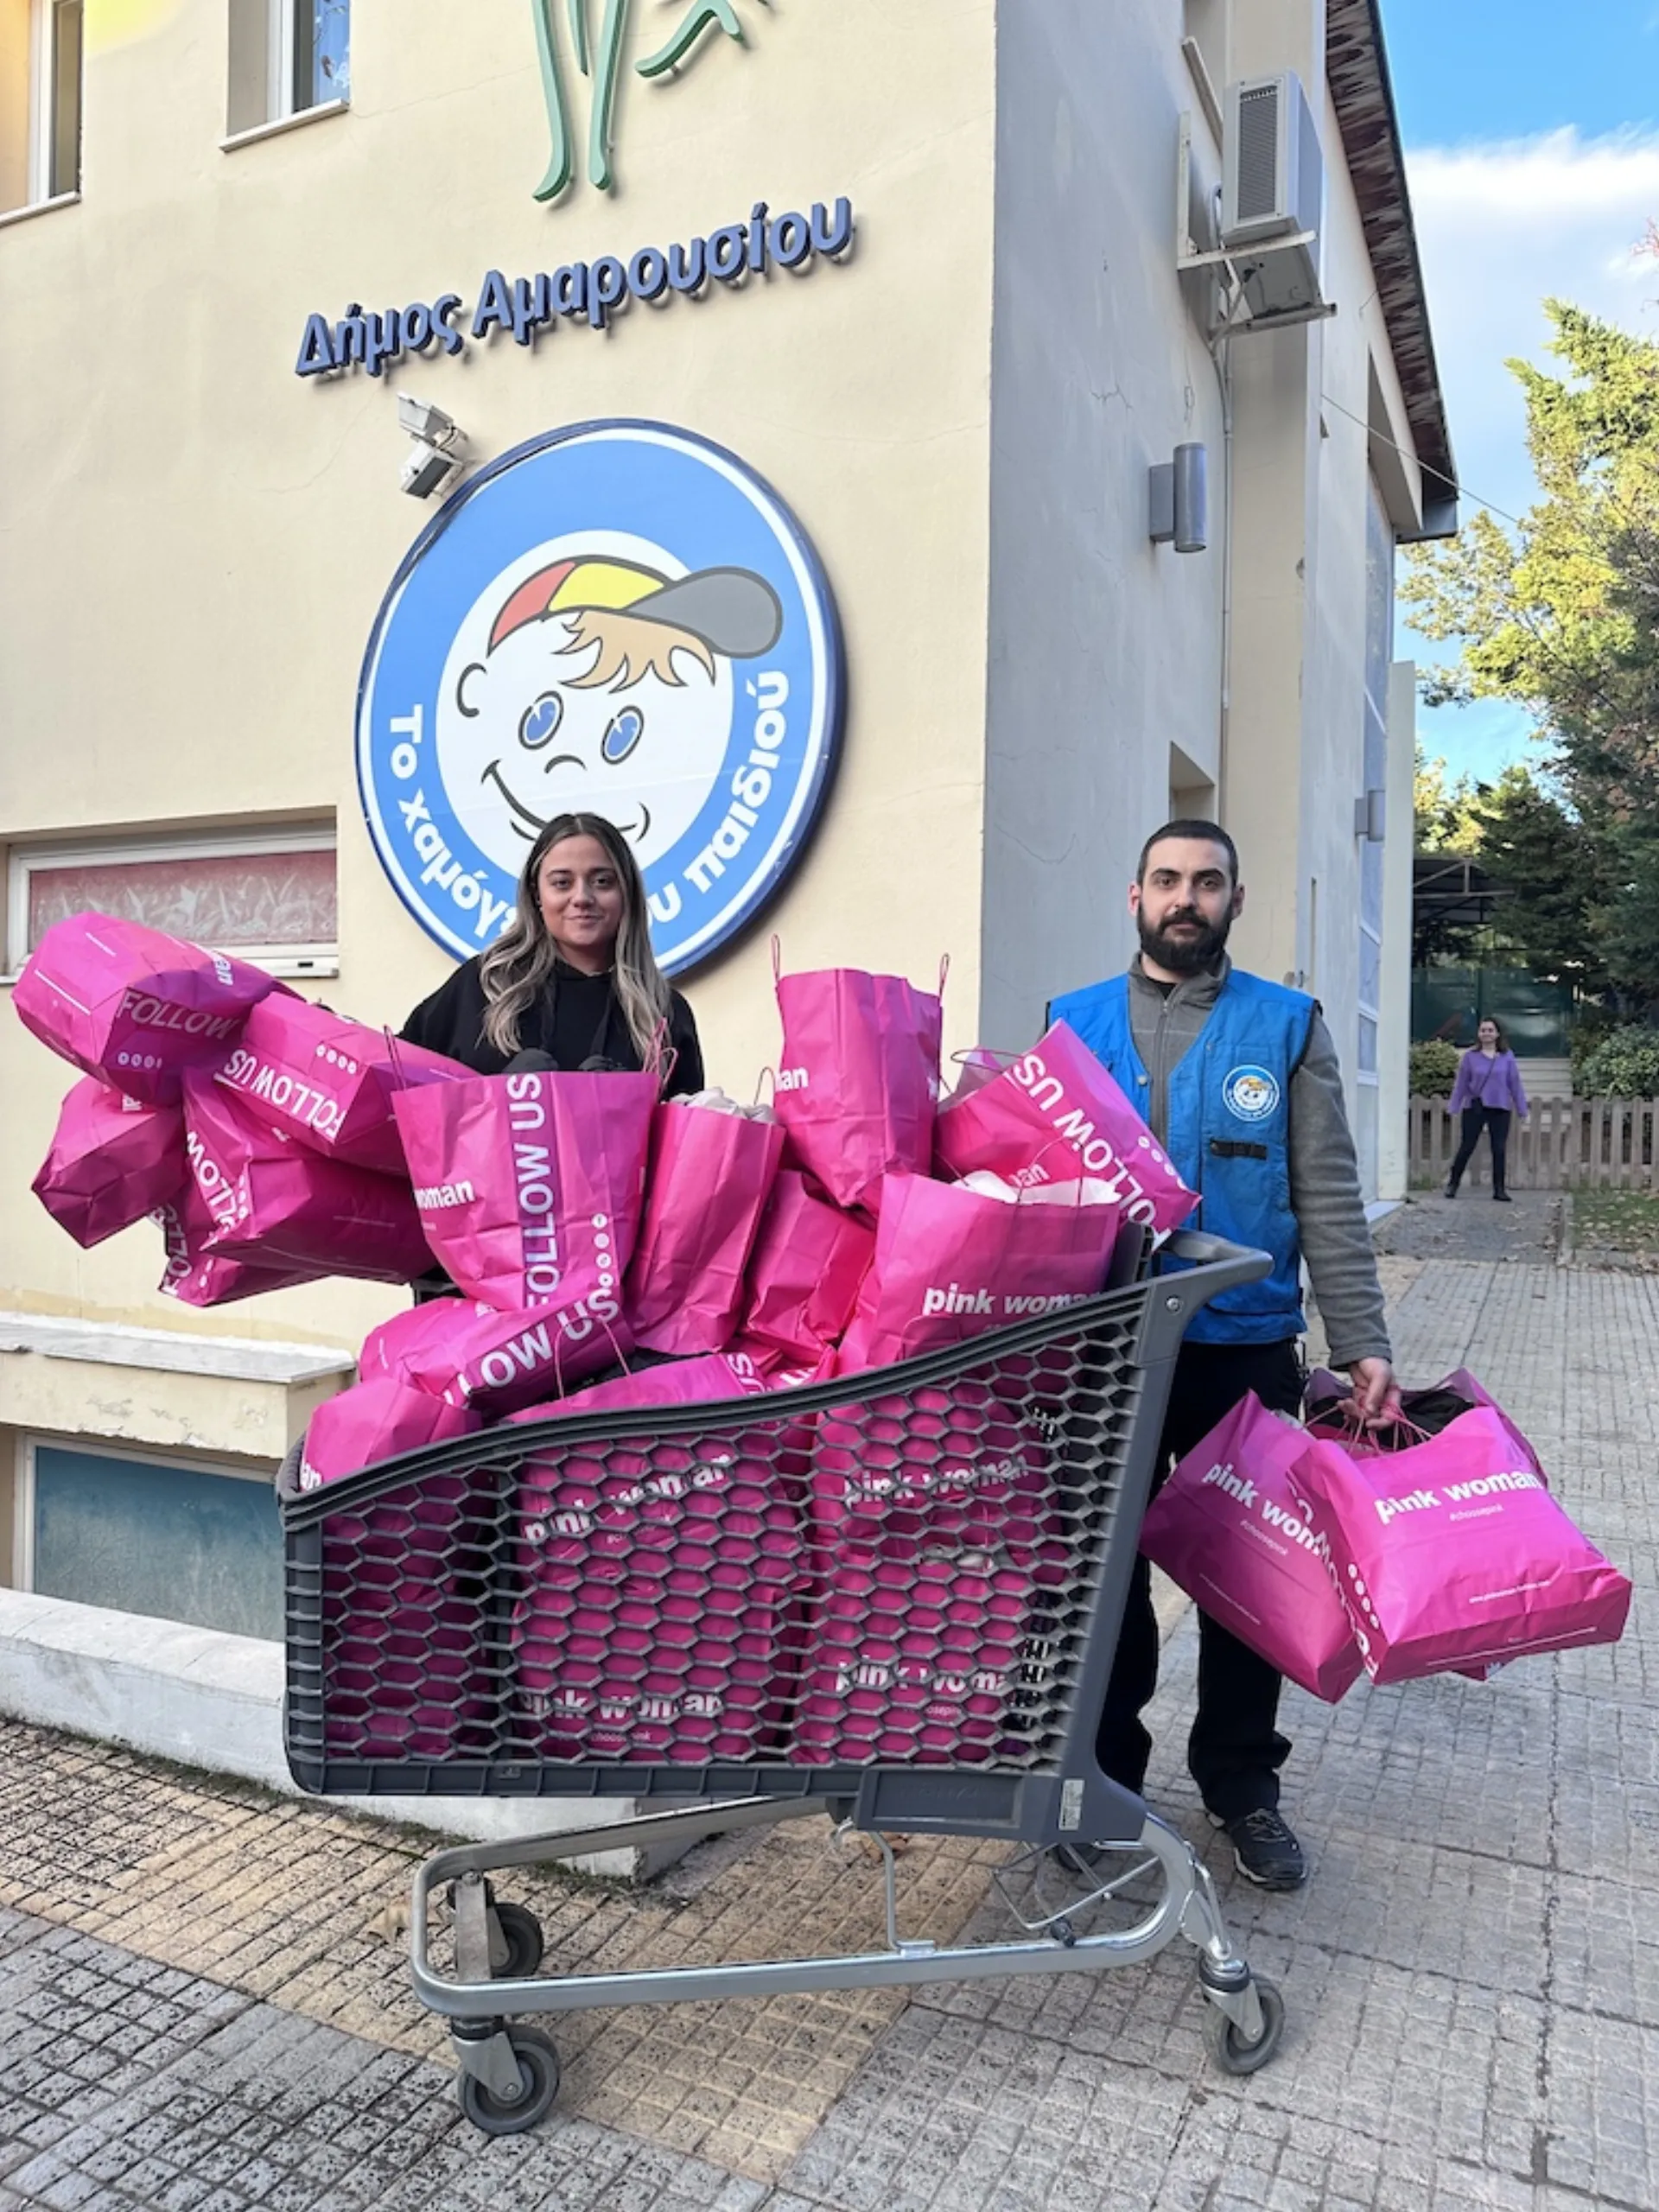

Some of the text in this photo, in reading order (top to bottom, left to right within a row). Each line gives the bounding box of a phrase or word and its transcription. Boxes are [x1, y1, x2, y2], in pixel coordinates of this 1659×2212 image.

[295, 195, 852, 378] Δήμος Αμαρουσίου
[390, 703, 424, 779] Το
[683, 671, 790, 894] παιδιού
[223, 1049, 257, 1084] US
[1013, 1053, 1064, 1112] US
[506, 1073, 546, 1131] US
[557, 1287, 620, 1341] US
[922, 1282, 996, 1316] pink
[1201, 1462, 1260, 1509] pink
[1374, 1471, 1545, 1526] pink woman
